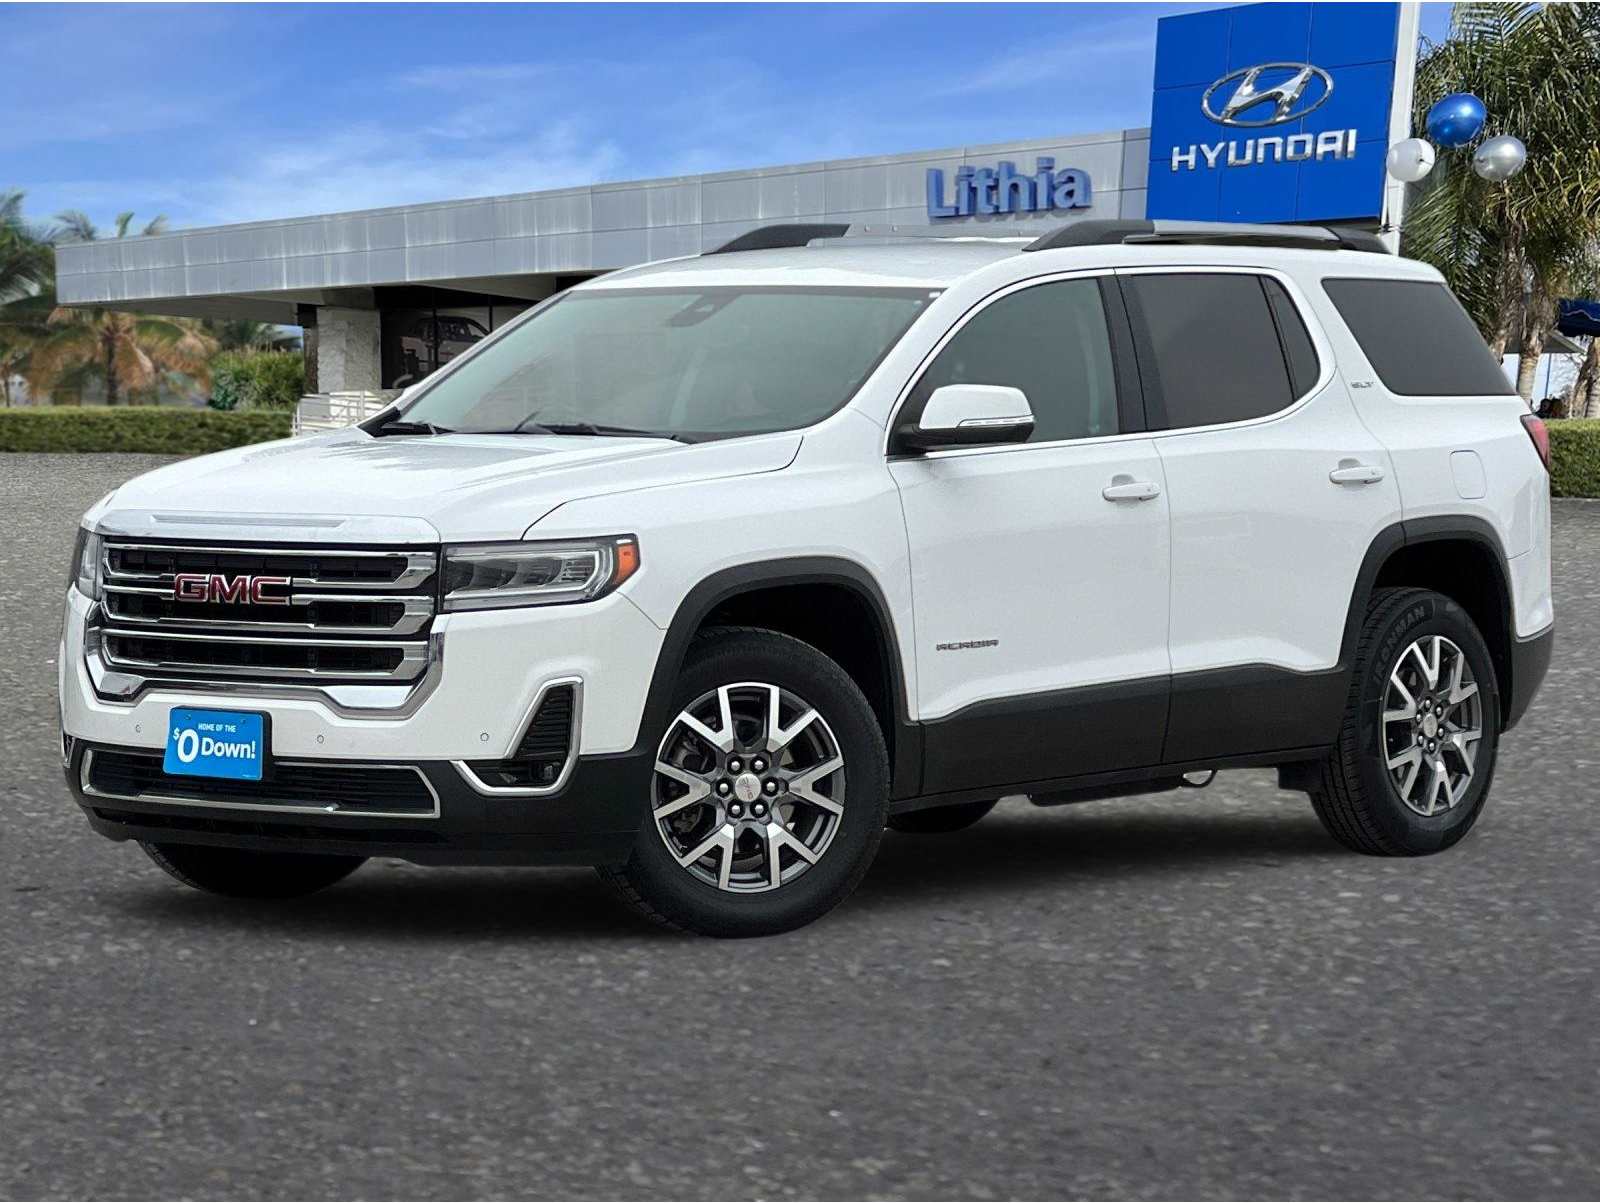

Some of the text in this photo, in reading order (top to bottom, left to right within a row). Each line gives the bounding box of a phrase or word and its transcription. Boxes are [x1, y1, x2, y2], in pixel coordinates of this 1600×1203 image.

[1171, 128, 1357, 171] HYUNDAI
[926, 156, 1093, 218] Lithia
[175, 573, 291, 606] GMC
[173, 727, 256, 763] $0 Down!
[198, 723, 237, 733] HOME OF THE
